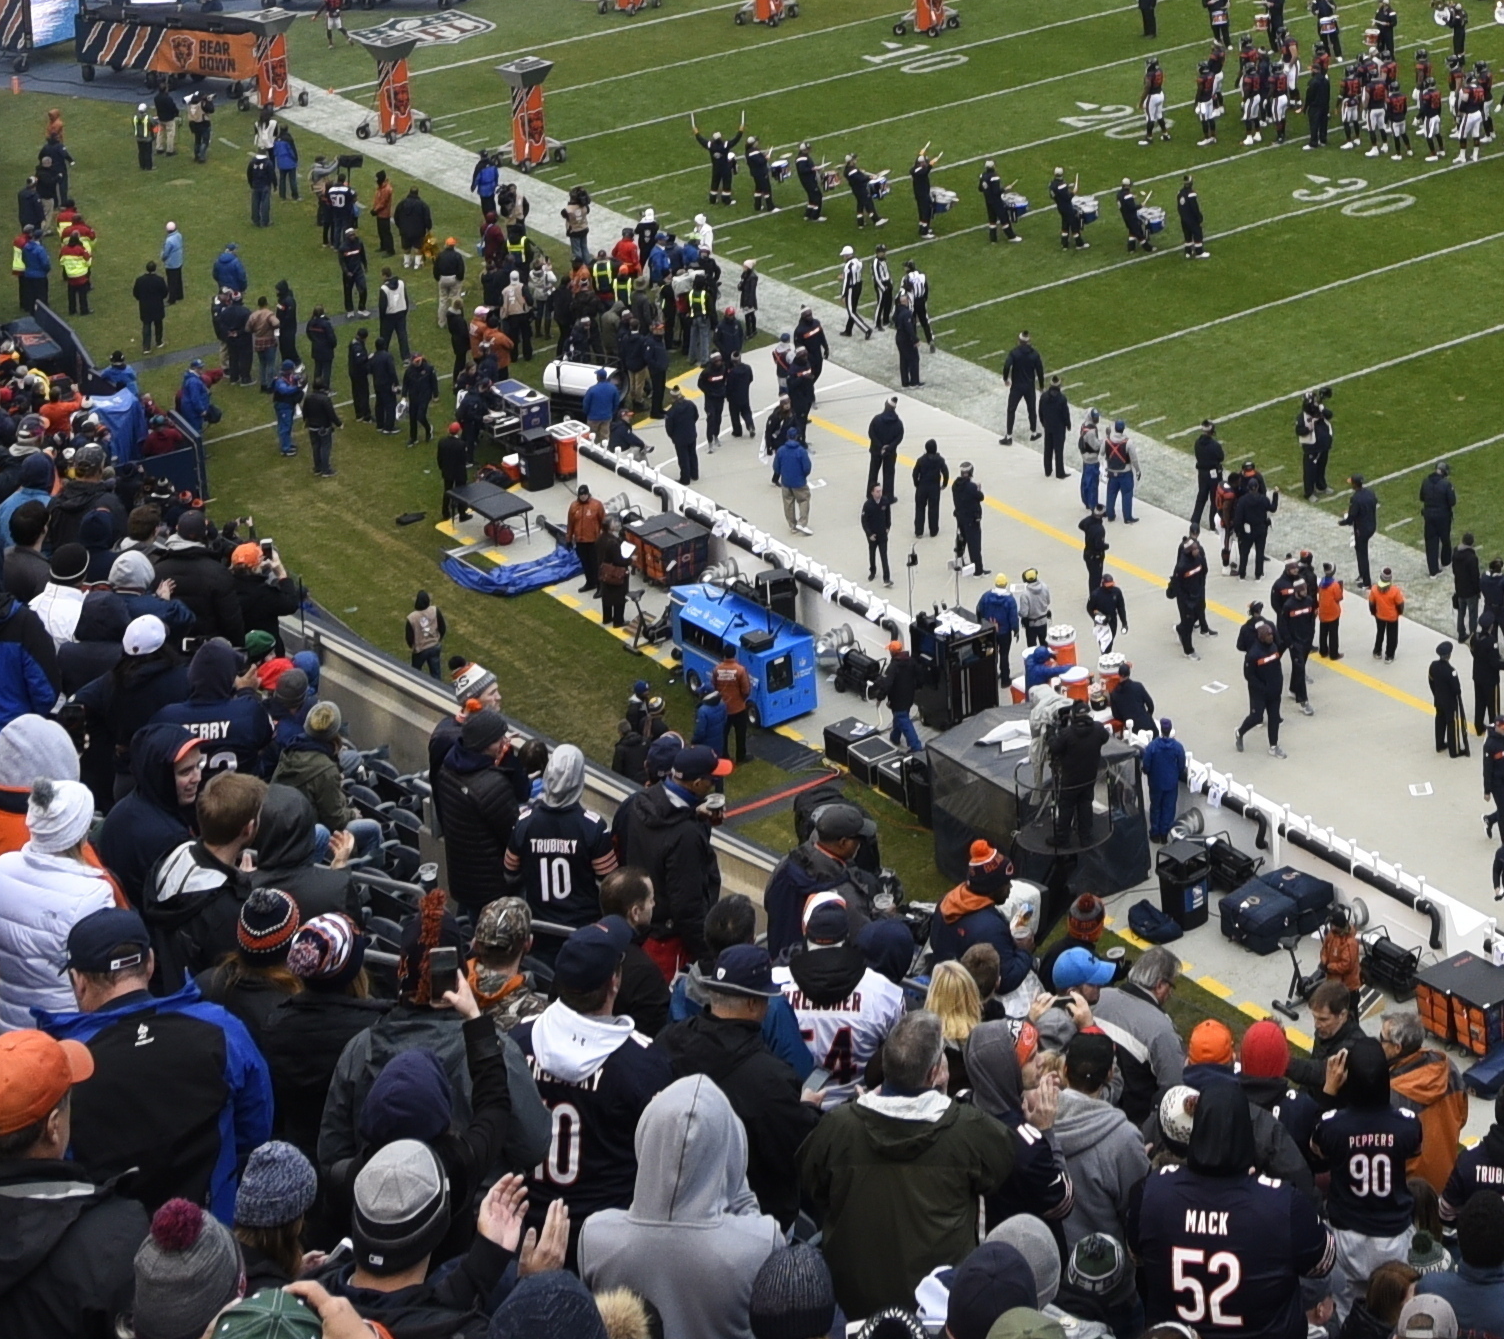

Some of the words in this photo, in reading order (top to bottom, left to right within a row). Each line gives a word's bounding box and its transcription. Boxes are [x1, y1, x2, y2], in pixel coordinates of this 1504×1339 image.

[199, 39, 230, 57] BEAR
[199, 55, 236, 73] DOWN
[530, 836, 579, 855] TRUBISKY
[539, 856, 573, 902] 10
[1348, 1132, 1394, 1149] PEPPERS
[1348, 1151, 1393, 1198] 90
[1184, 1208, 1230, 1237] MACK
[1170, 1244, 1246, 1327] 52
